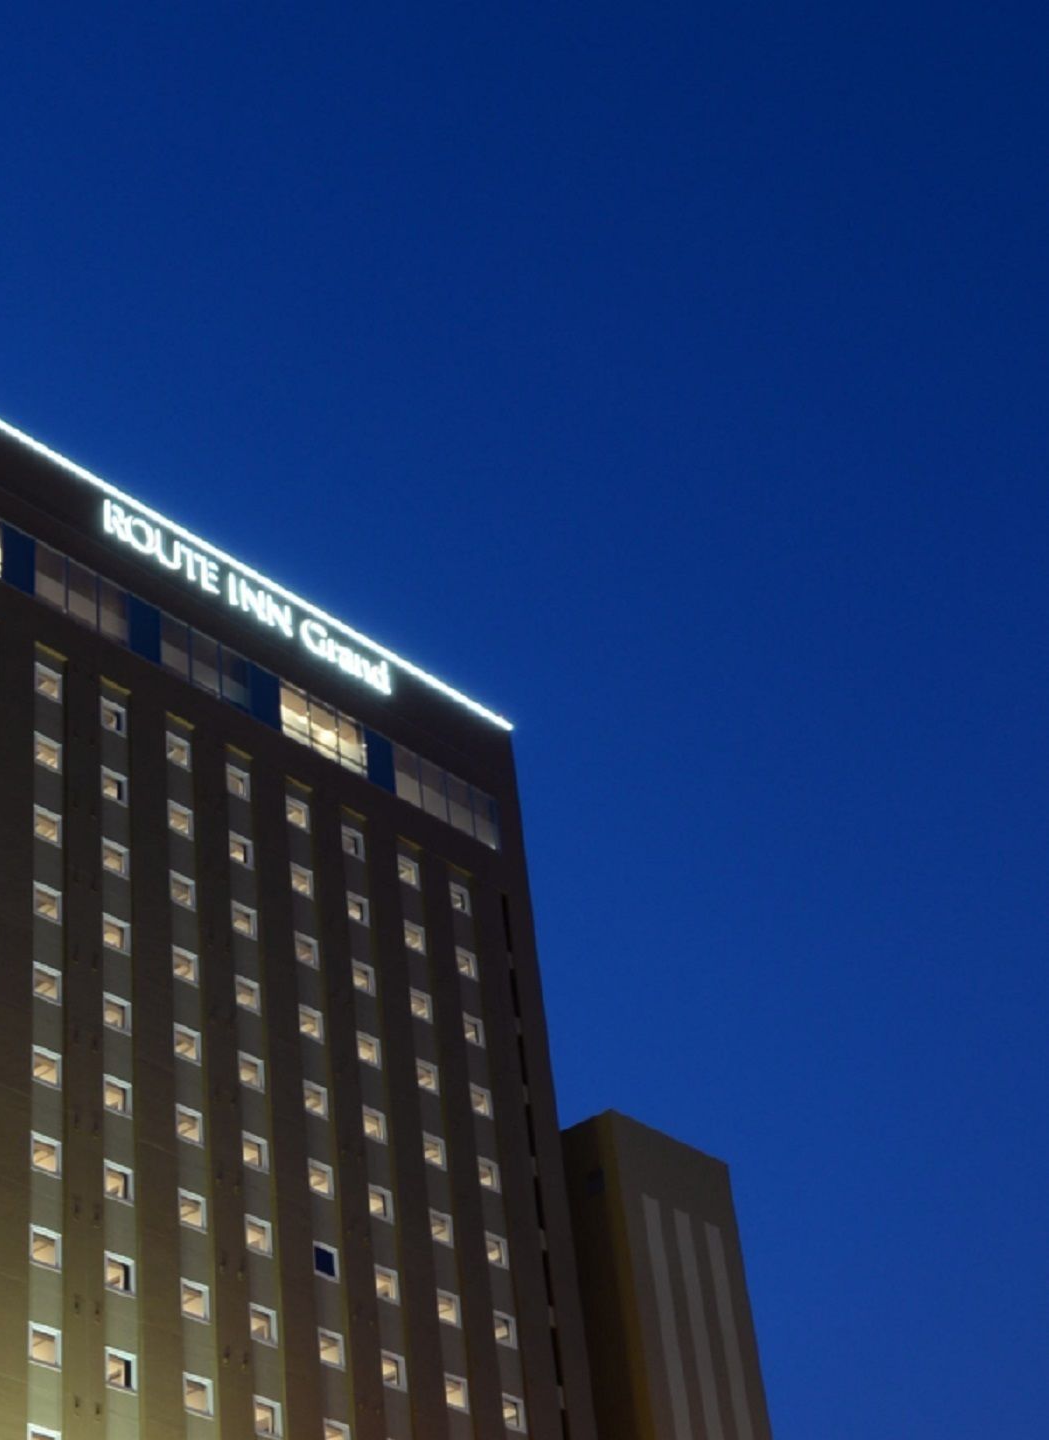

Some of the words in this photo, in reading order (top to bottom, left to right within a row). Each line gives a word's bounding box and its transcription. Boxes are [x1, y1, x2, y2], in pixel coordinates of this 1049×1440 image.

[102, 498, 221, 595] ROUTE
[227, 571, 294, 638] INN
[300, 618, 393, 696] Grand
